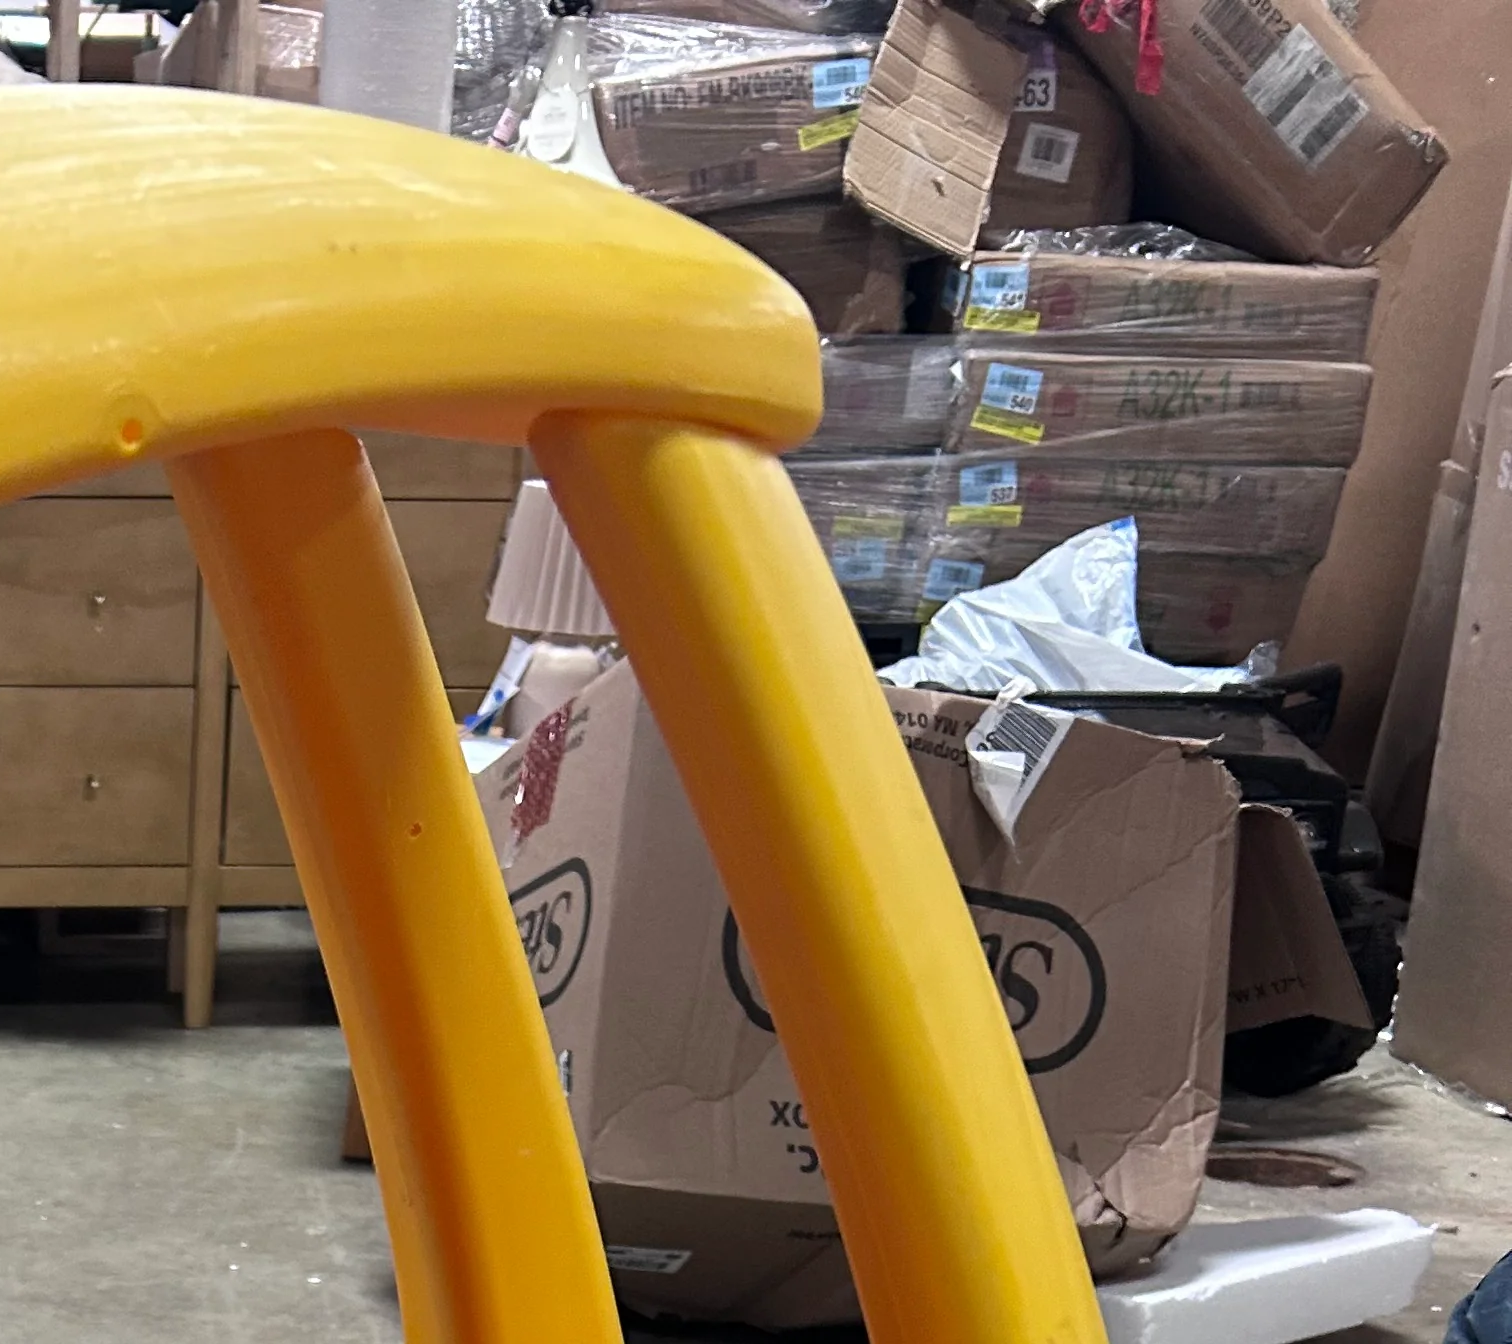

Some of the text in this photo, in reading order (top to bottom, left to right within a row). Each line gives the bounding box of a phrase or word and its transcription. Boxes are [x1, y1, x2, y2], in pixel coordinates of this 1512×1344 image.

[1014, 78, 1050, 106] 63
[1117, 369, 1232, 419] A32K-1
[901, 734, 969, 768] Corporat
